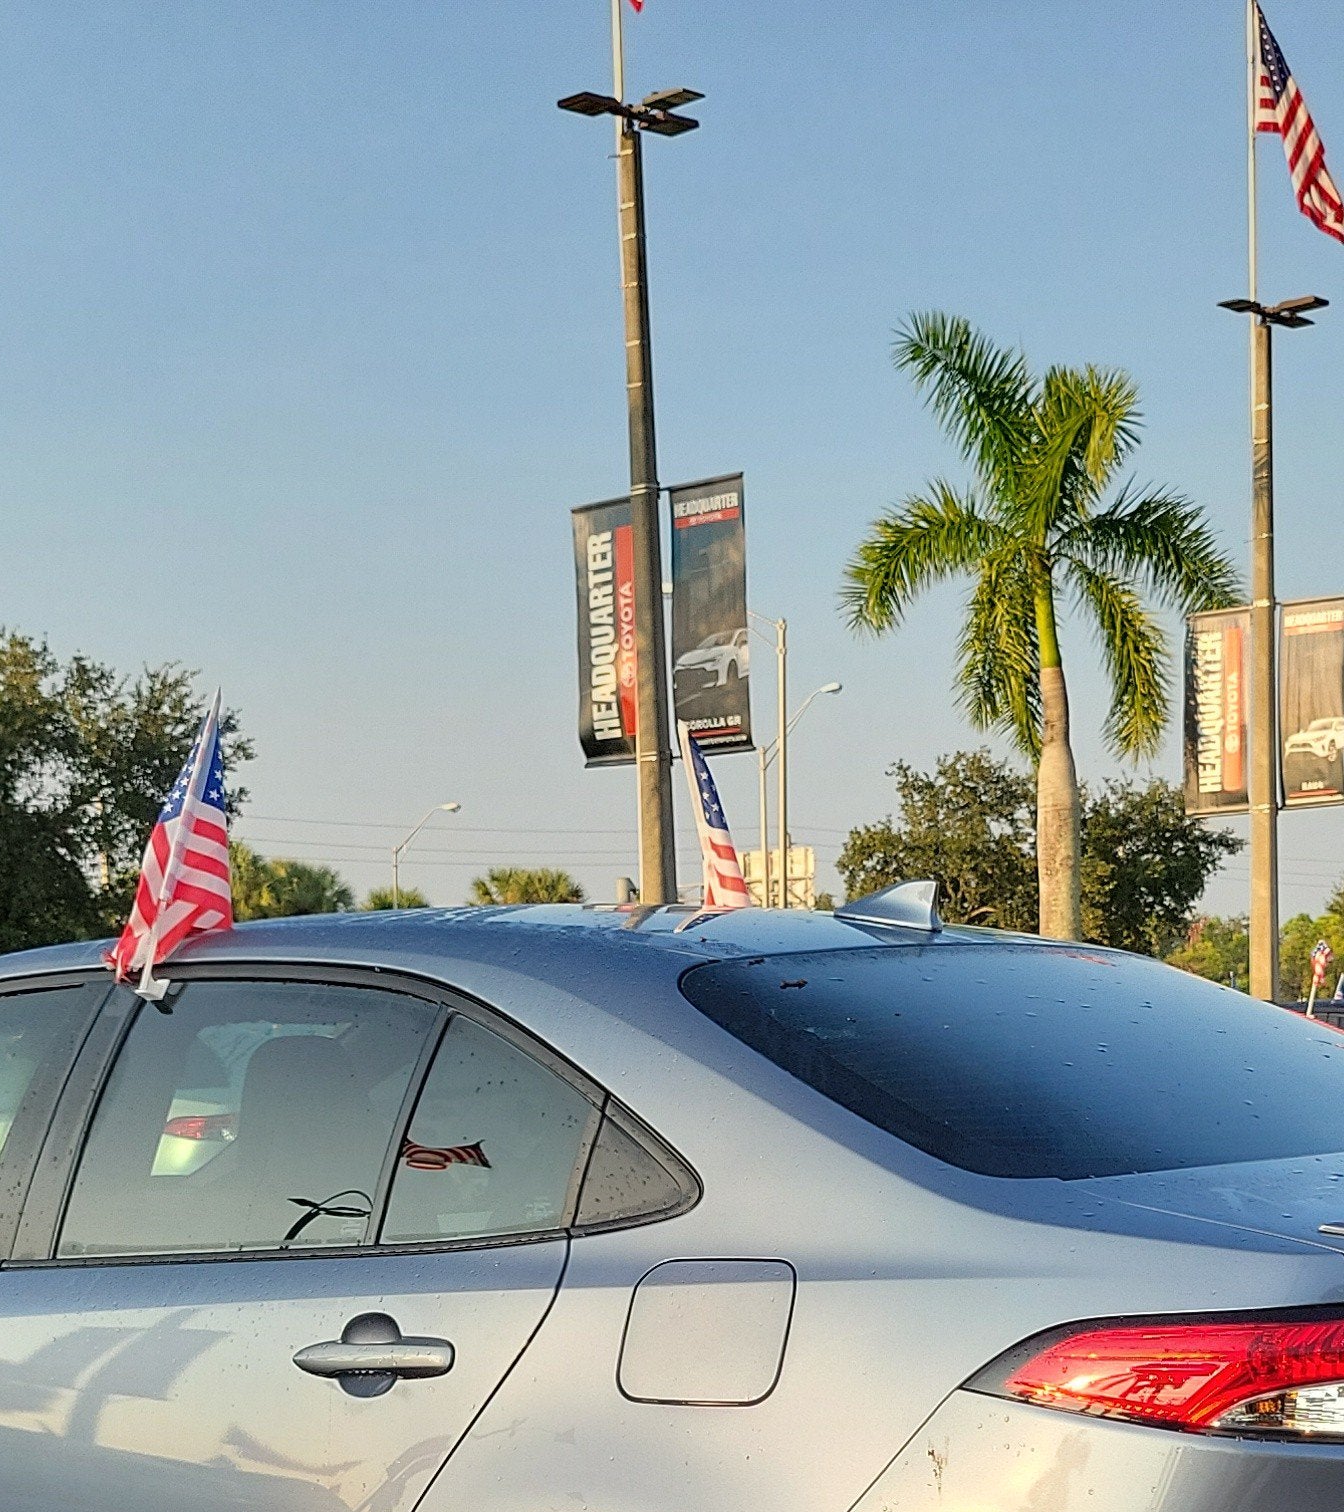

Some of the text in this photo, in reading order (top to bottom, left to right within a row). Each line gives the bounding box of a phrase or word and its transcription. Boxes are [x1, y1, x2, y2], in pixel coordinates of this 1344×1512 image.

[674, 492, 739, 518] HEADQUARTER
[587, 530, 623, 741] HEADQUARTER
[619, 580, 636, 661] TOYOTA
[1196, 630, 1225, 793] HEADQUARTER
[1226, 673, 1239, 735] TOYOTA
